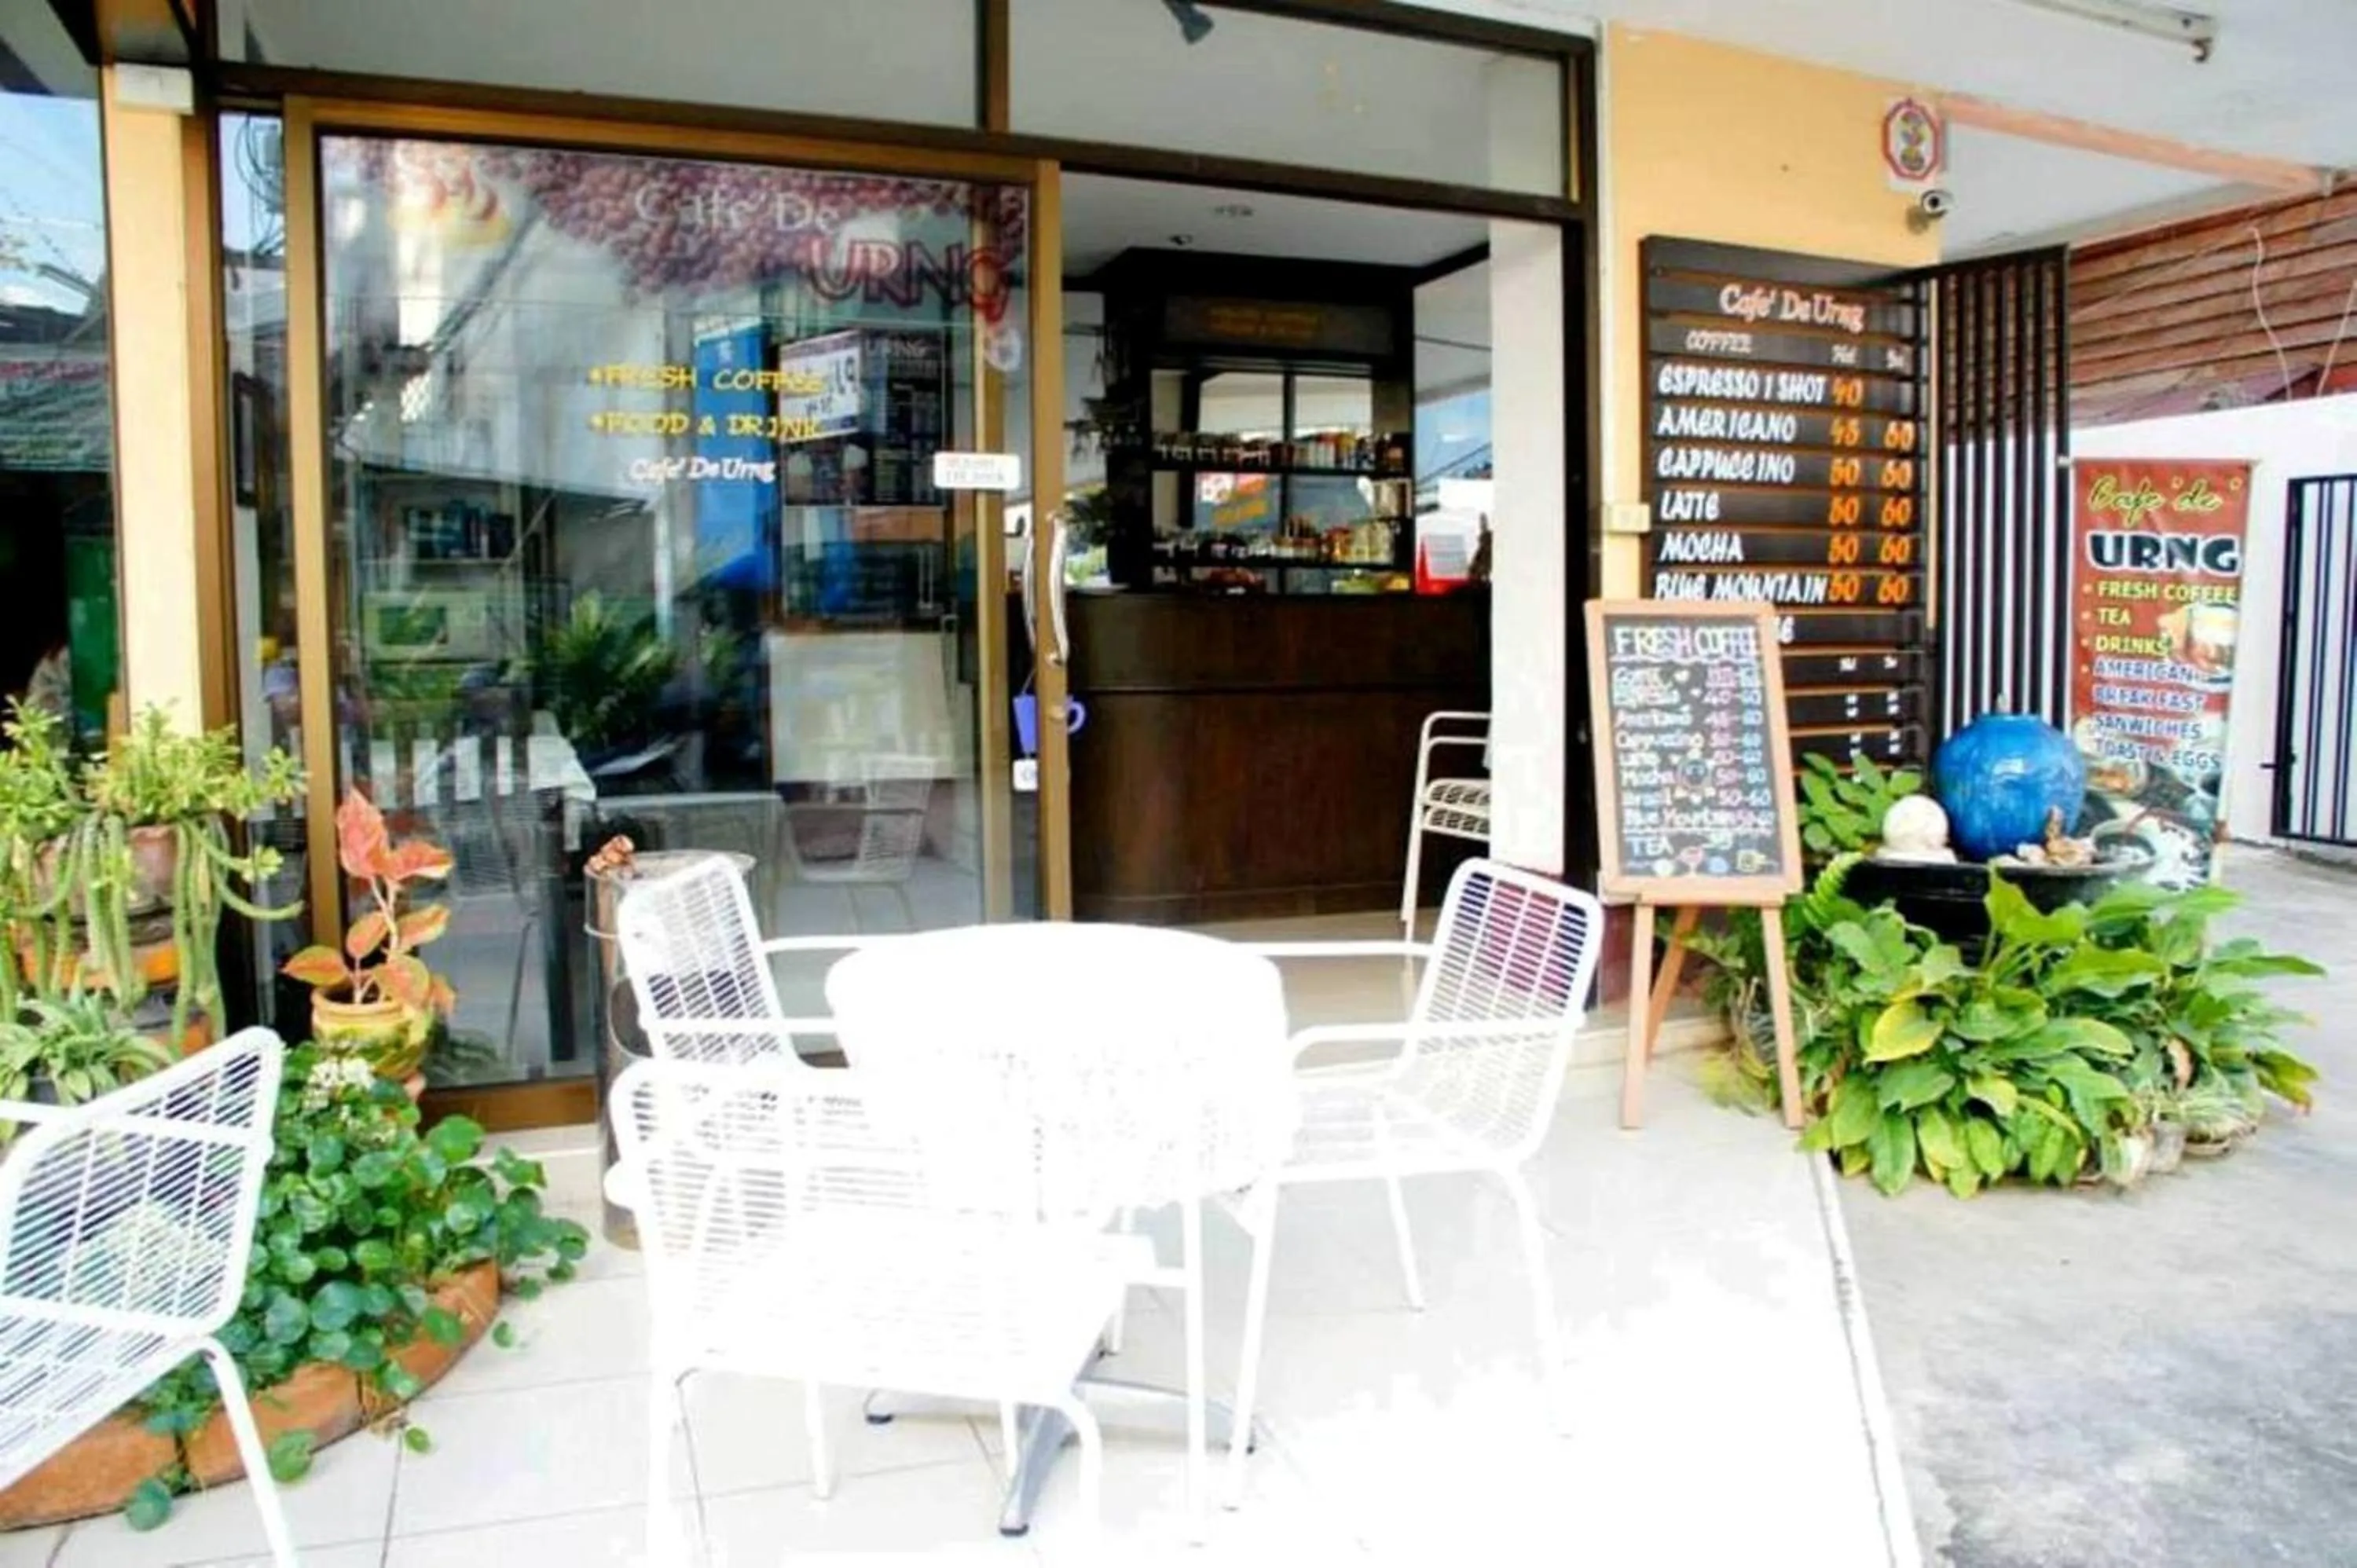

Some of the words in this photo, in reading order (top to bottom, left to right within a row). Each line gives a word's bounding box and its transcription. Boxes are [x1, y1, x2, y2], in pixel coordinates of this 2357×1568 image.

[1686, 330, 1753, 354] COFFEE
[1658, 363, 1759, 398] ESPRESSO
[1777, 372, 1827, 403] SHOT
[1833, 377, 1863, 407] 40
[1657, 407, 1797, 442] AMERICANO
[1831, 416, 1860, 446] 45
[1658, 447, 1795, 483] CAPPUCCINO
[1660, 491, 1721, 521] LATTE
[1659, 532, 1743, 562] MOCHA
[2087, 531, 2240, 576] URNG
[1710, 573, 1829, 603] MOUNTAIN
[2097, 581, 2157, 599] FRESH
[2163, 584, 2238, 603] COFFEE
[2098, 607, 2131, 625] TEA
[1615, 626, 1692, 658] FRESH
[2095, 634, 2172, 655] DRINKS
[2094, 658, 2194, 683] AMERICAN
[2093, 685, 2205, 711] BREAKFAST
[2172, 749, 2221, 769] EGGS
[1626, 834, 1676, 857] TEA
